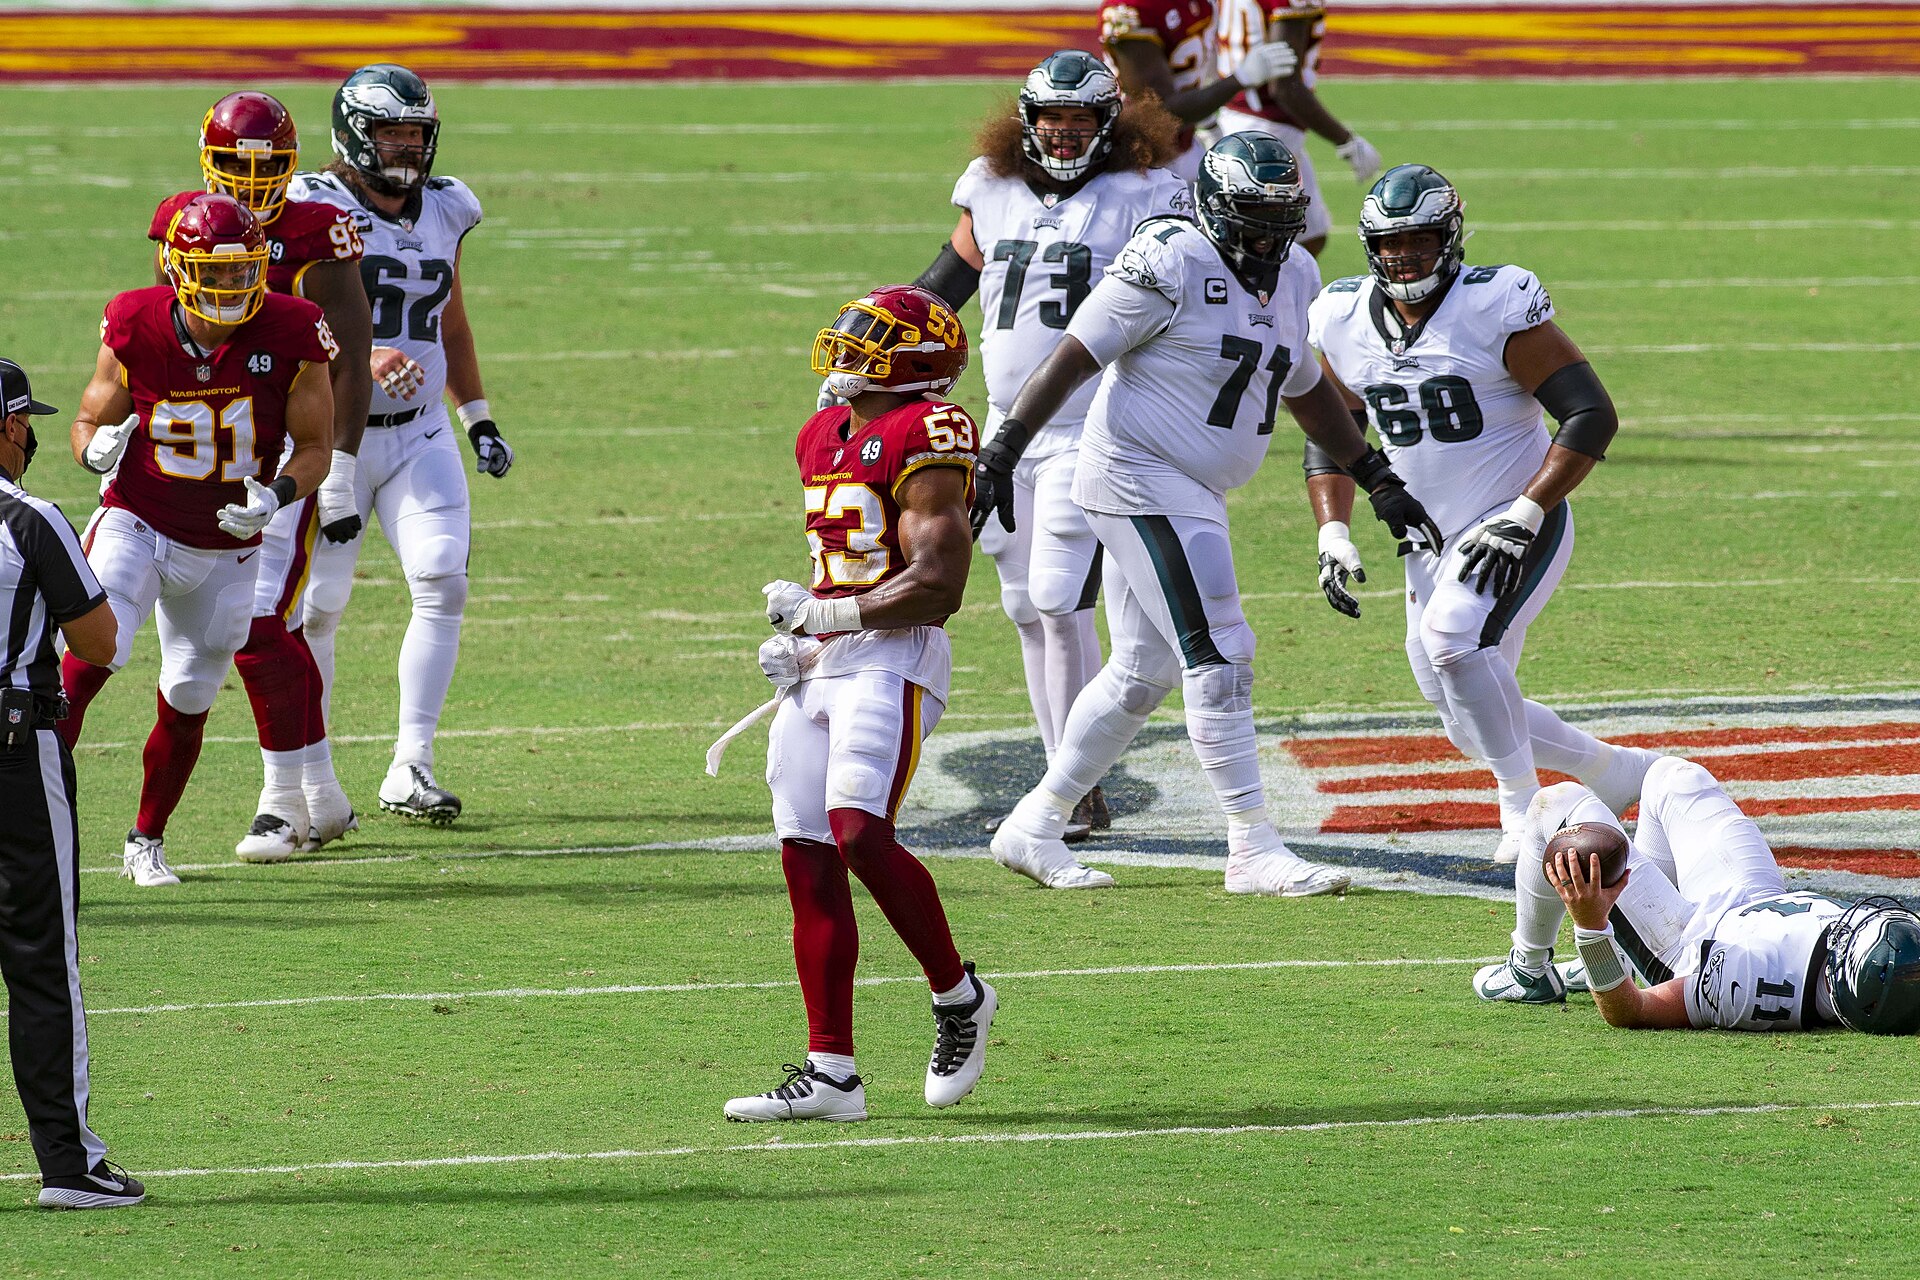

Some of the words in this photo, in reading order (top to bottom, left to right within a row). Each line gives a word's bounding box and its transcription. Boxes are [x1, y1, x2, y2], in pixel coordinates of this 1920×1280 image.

[328, 216, 363, 259] 93
[360, 254, 453, 343] 62
[994, 239, 1092, 330] 73
[1206, 279, 1227, 298] C
[926, 303, 960, 349] 53
[248, 354, 272, 373] 49
[1206, 333, 1293, 435] 71
[170, 385, 240, 398] WASHINGTON
[1364, 375, 1483, 446] 68
[149, 396, 264, 483] 91
[861, 440, 881, 460] 49
[923, 411, 974, 452] 53
[811, 472, 853, 482] WASHINGTON
[1750, 978, 1796, 1022] 11
